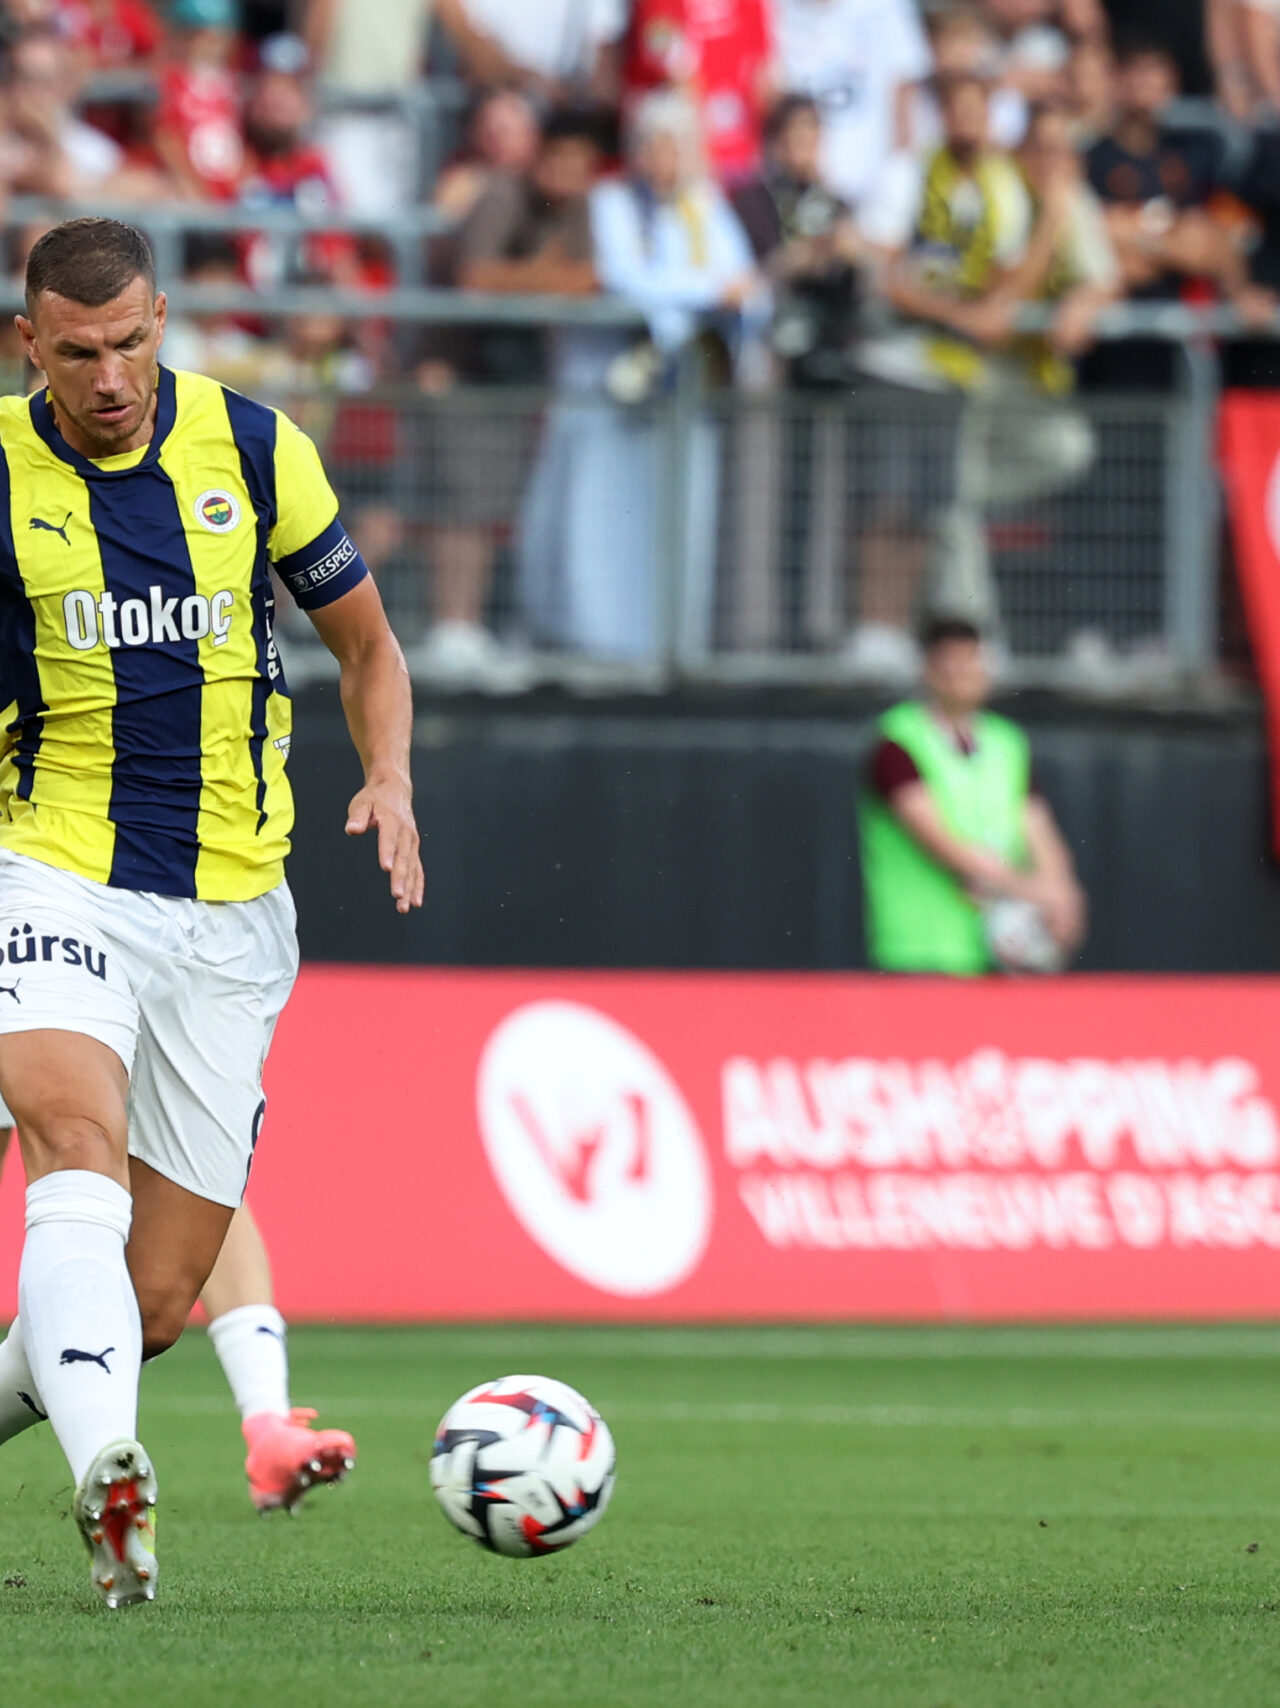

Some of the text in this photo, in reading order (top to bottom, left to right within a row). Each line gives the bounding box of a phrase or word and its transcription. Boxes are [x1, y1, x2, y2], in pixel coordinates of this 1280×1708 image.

[309, 539, 355, 583] RESPECT
[62, 585, 234, 650] Otokoç
[739, 1172, 1110, 1249] VILLENEUVE
